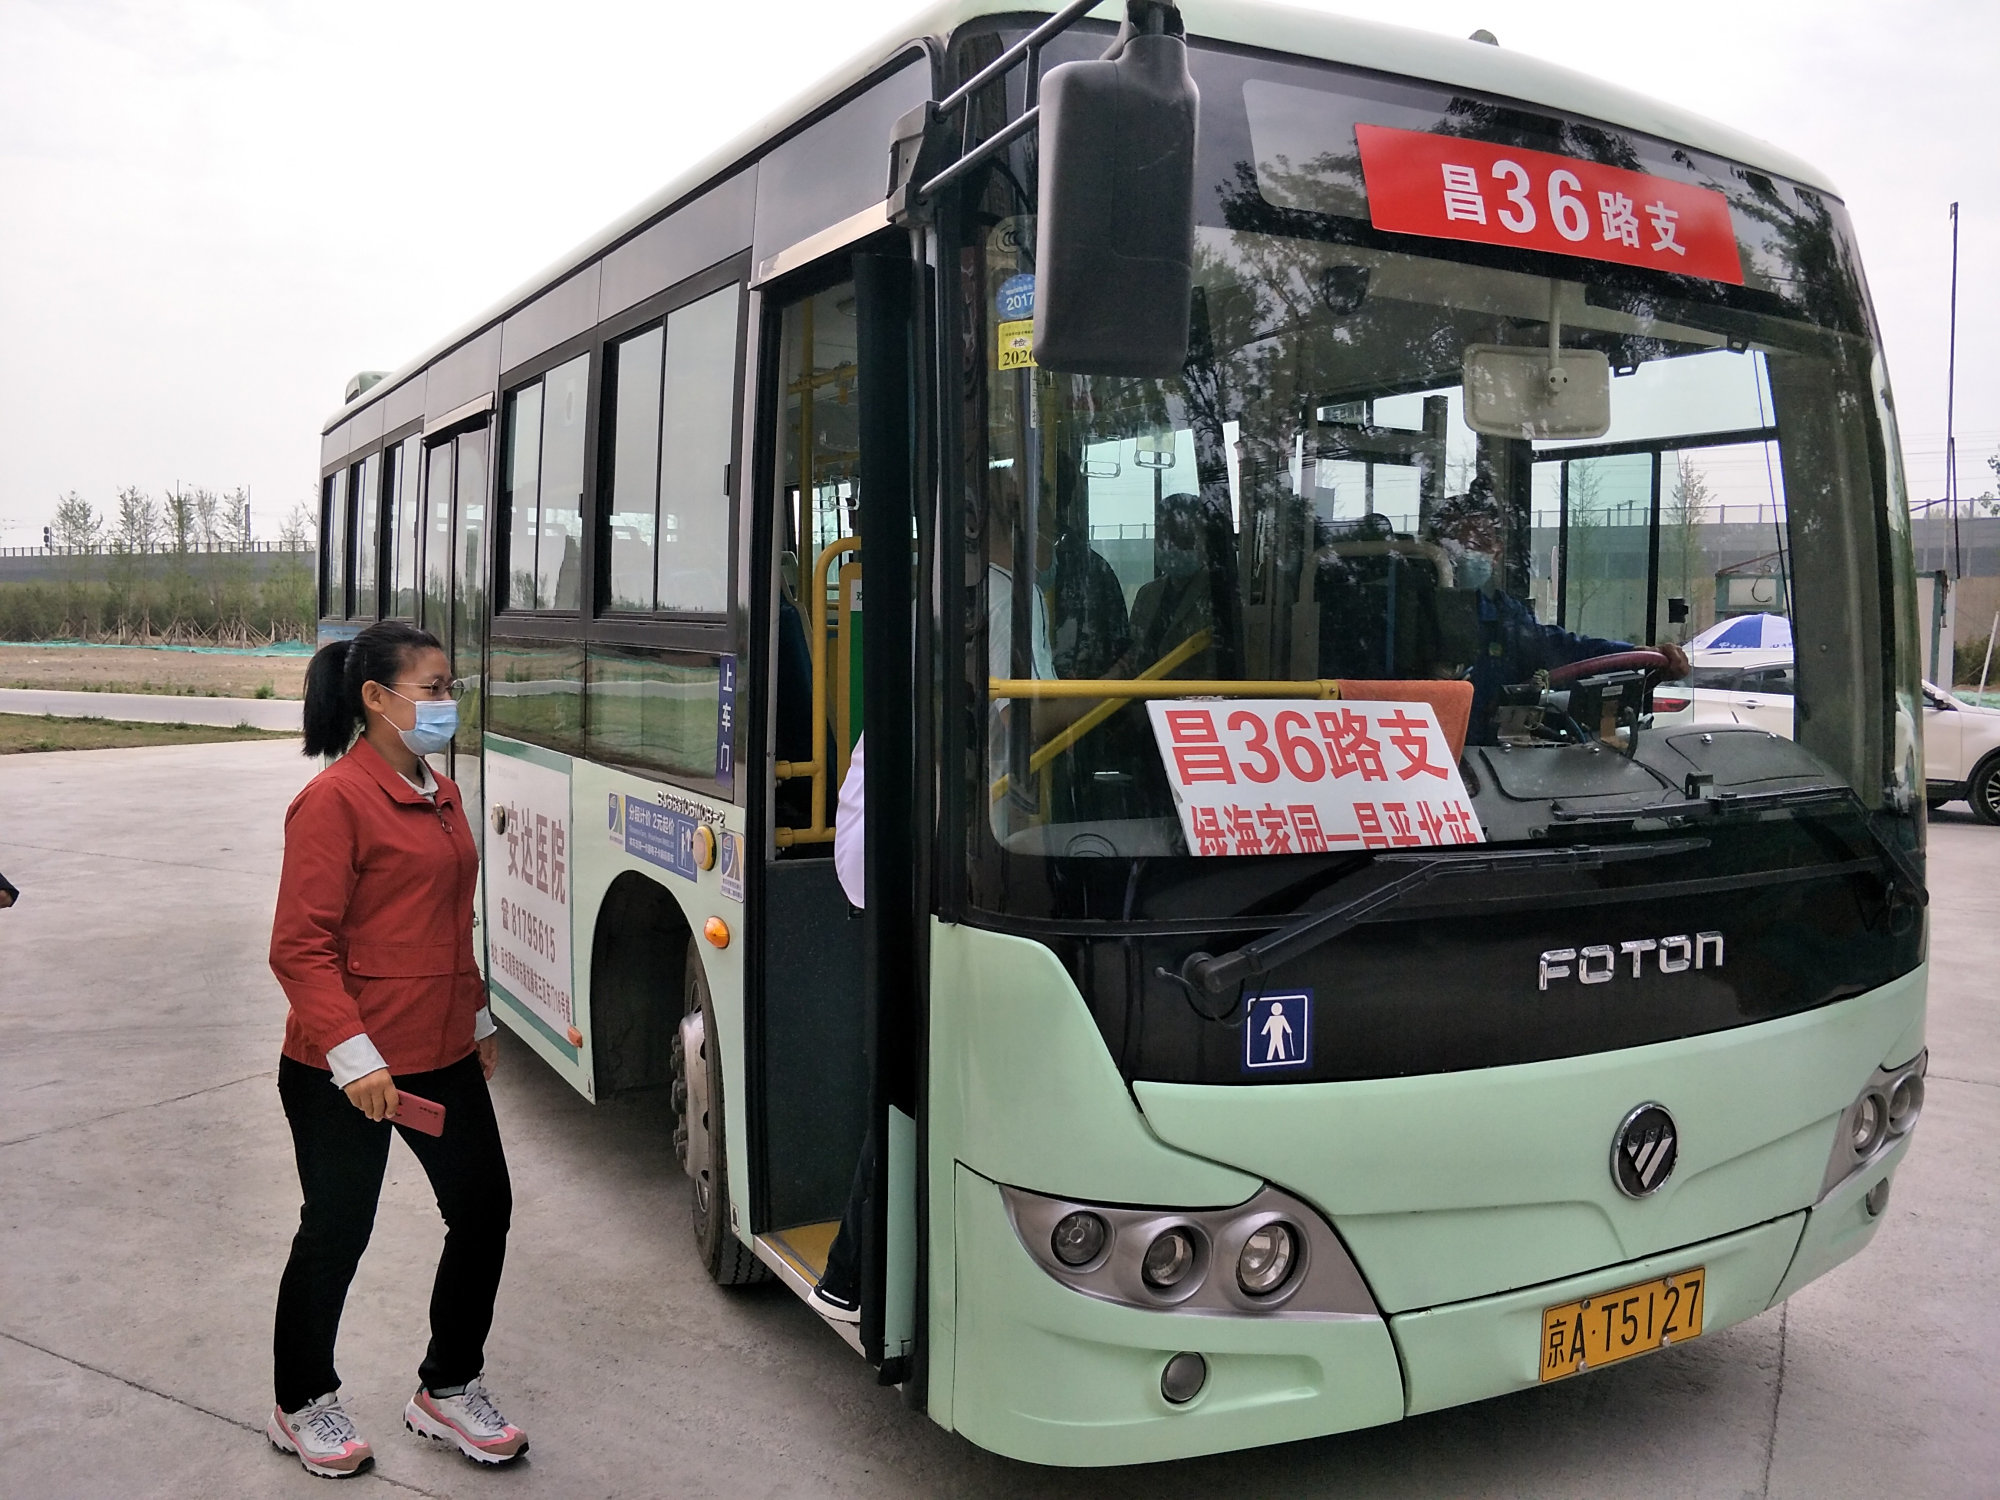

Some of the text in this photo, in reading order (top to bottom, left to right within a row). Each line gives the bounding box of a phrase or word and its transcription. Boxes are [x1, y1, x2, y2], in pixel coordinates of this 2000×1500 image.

[1441, 159, 1686, 256] 昌36路支
[1006, 292, 1035, 311] 2017
[1165, 708, 1449, 785] 昌36路支
[507, 800, 566, 905] 安达医院
[511, 902, 556, 963] 81795615
[1538, 930, 1724, 991] FOTON
